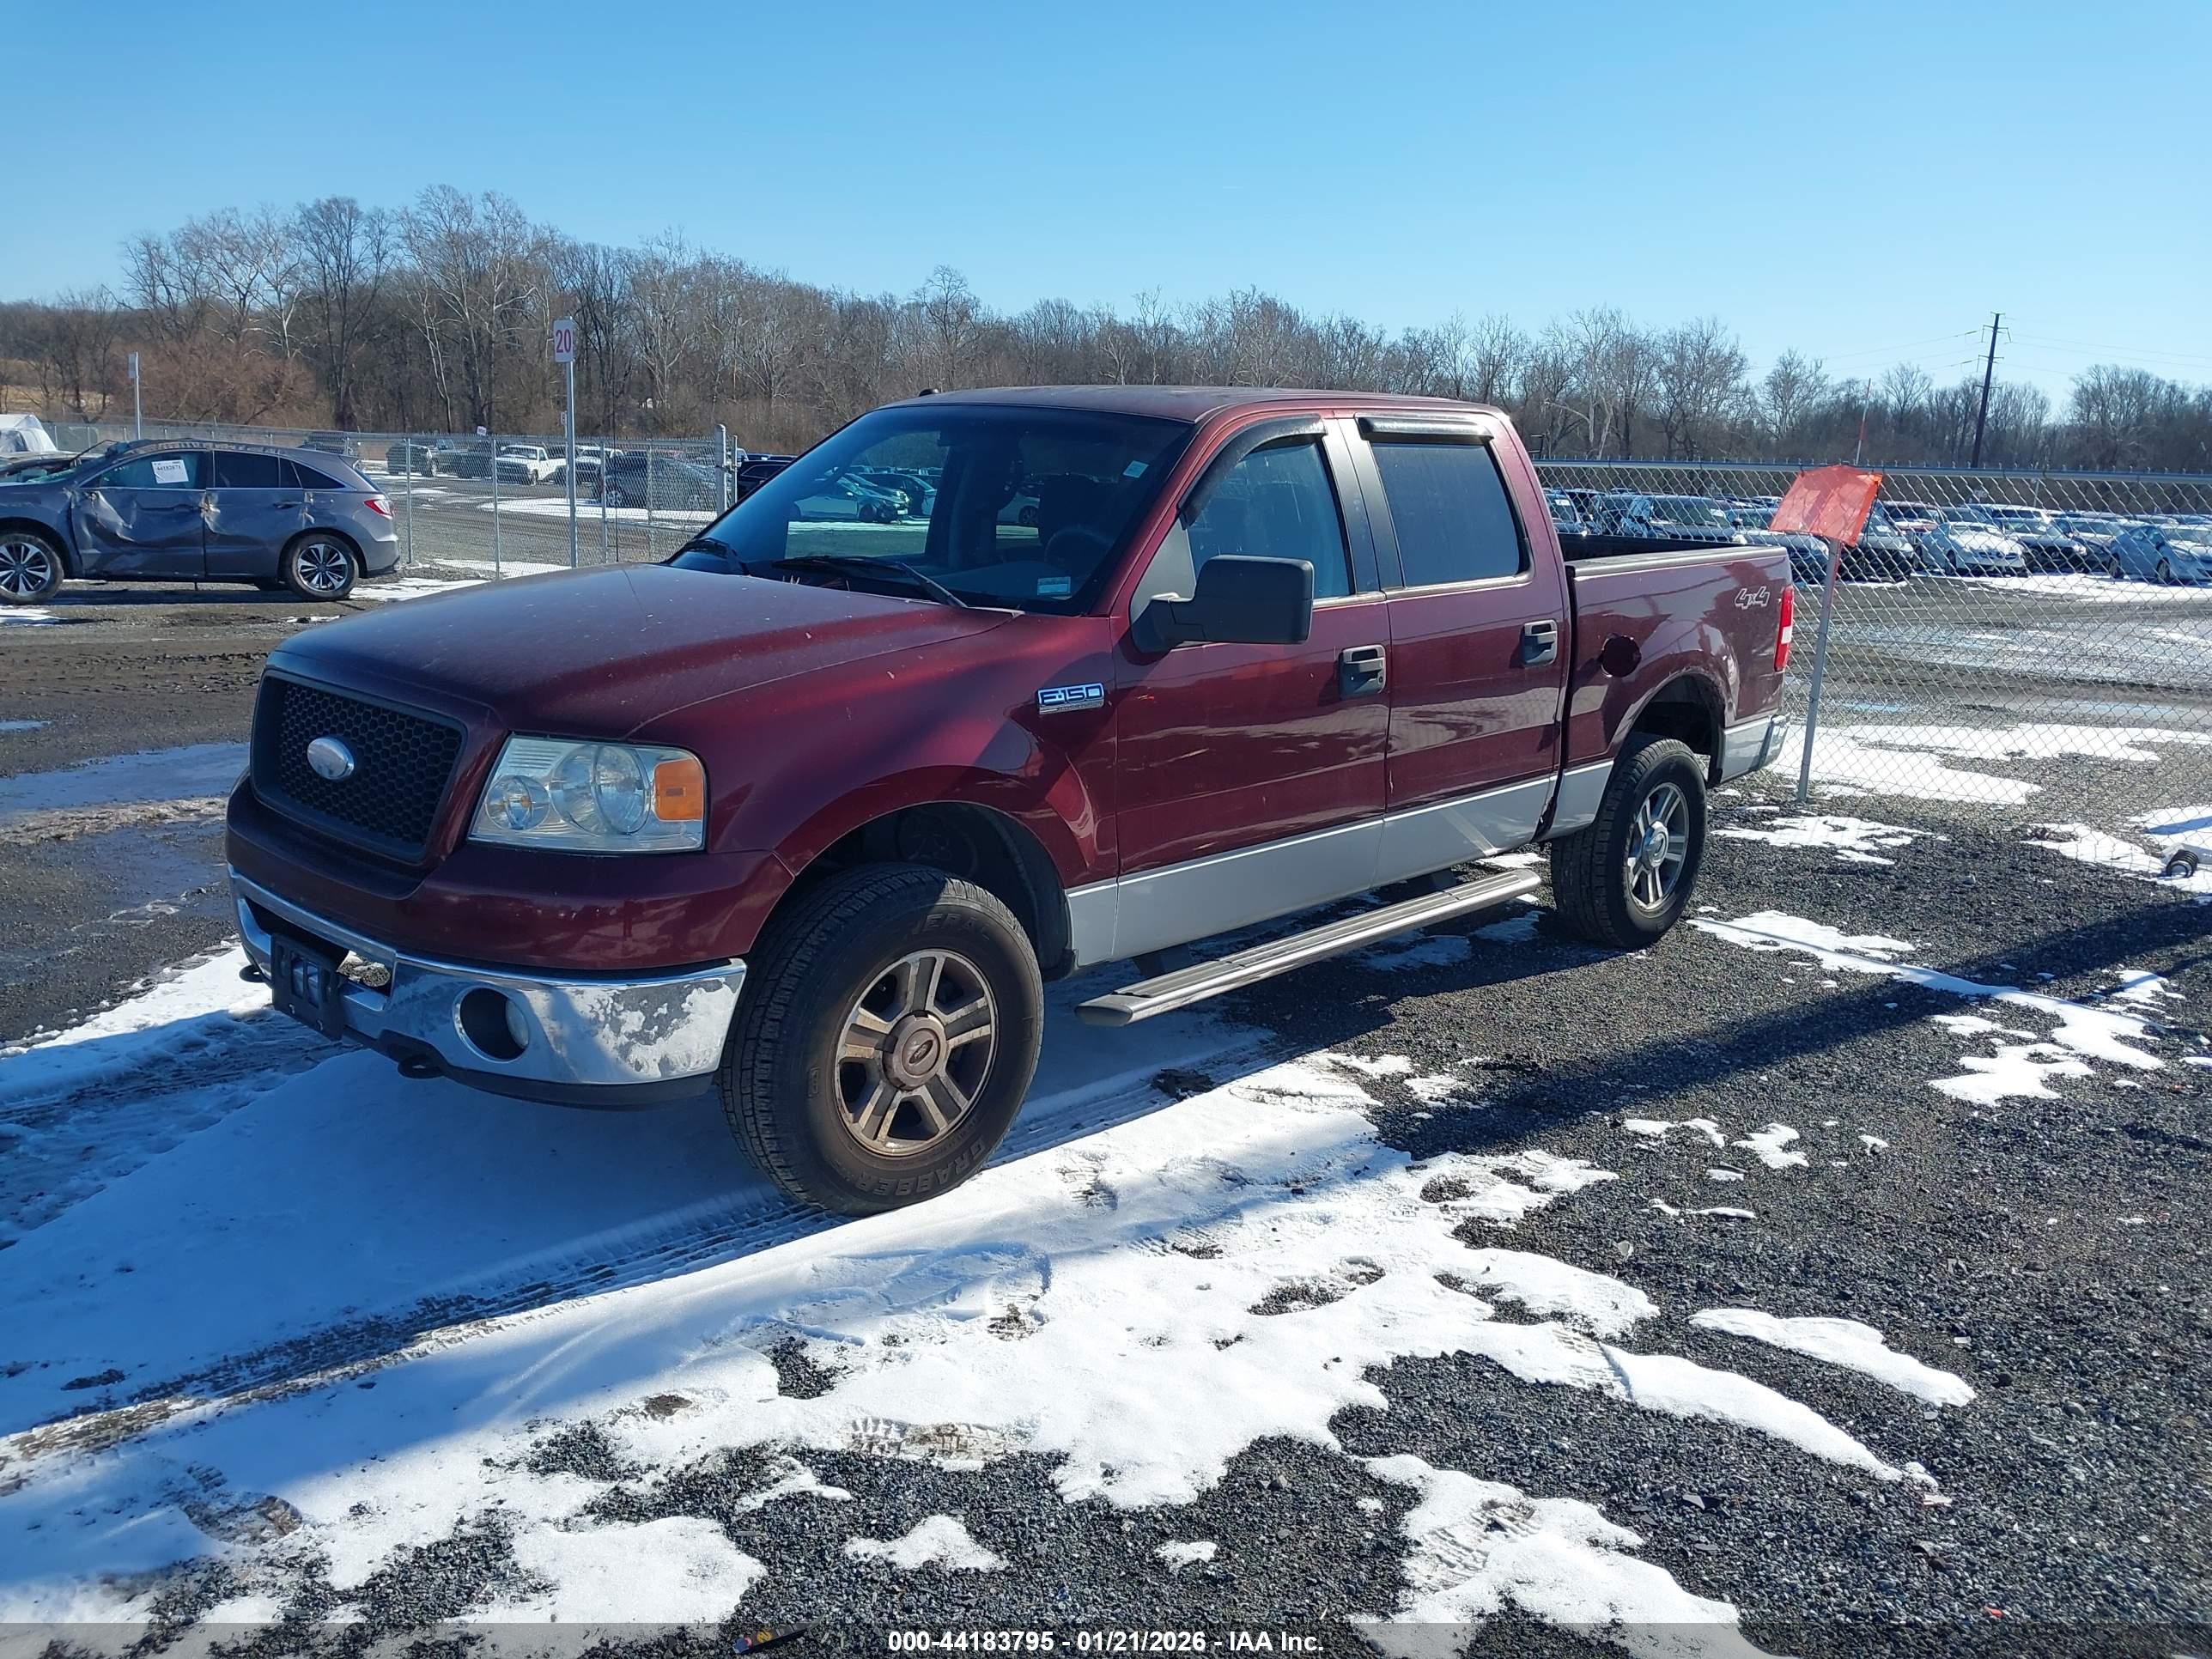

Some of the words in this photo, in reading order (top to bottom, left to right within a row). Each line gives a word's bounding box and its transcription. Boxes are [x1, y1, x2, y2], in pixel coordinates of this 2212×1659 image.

[556, 329, 571, 353] 20
[1735, 586, 1770, 610] 4x4
[854, 1136, 985, 1196] GRABBER
